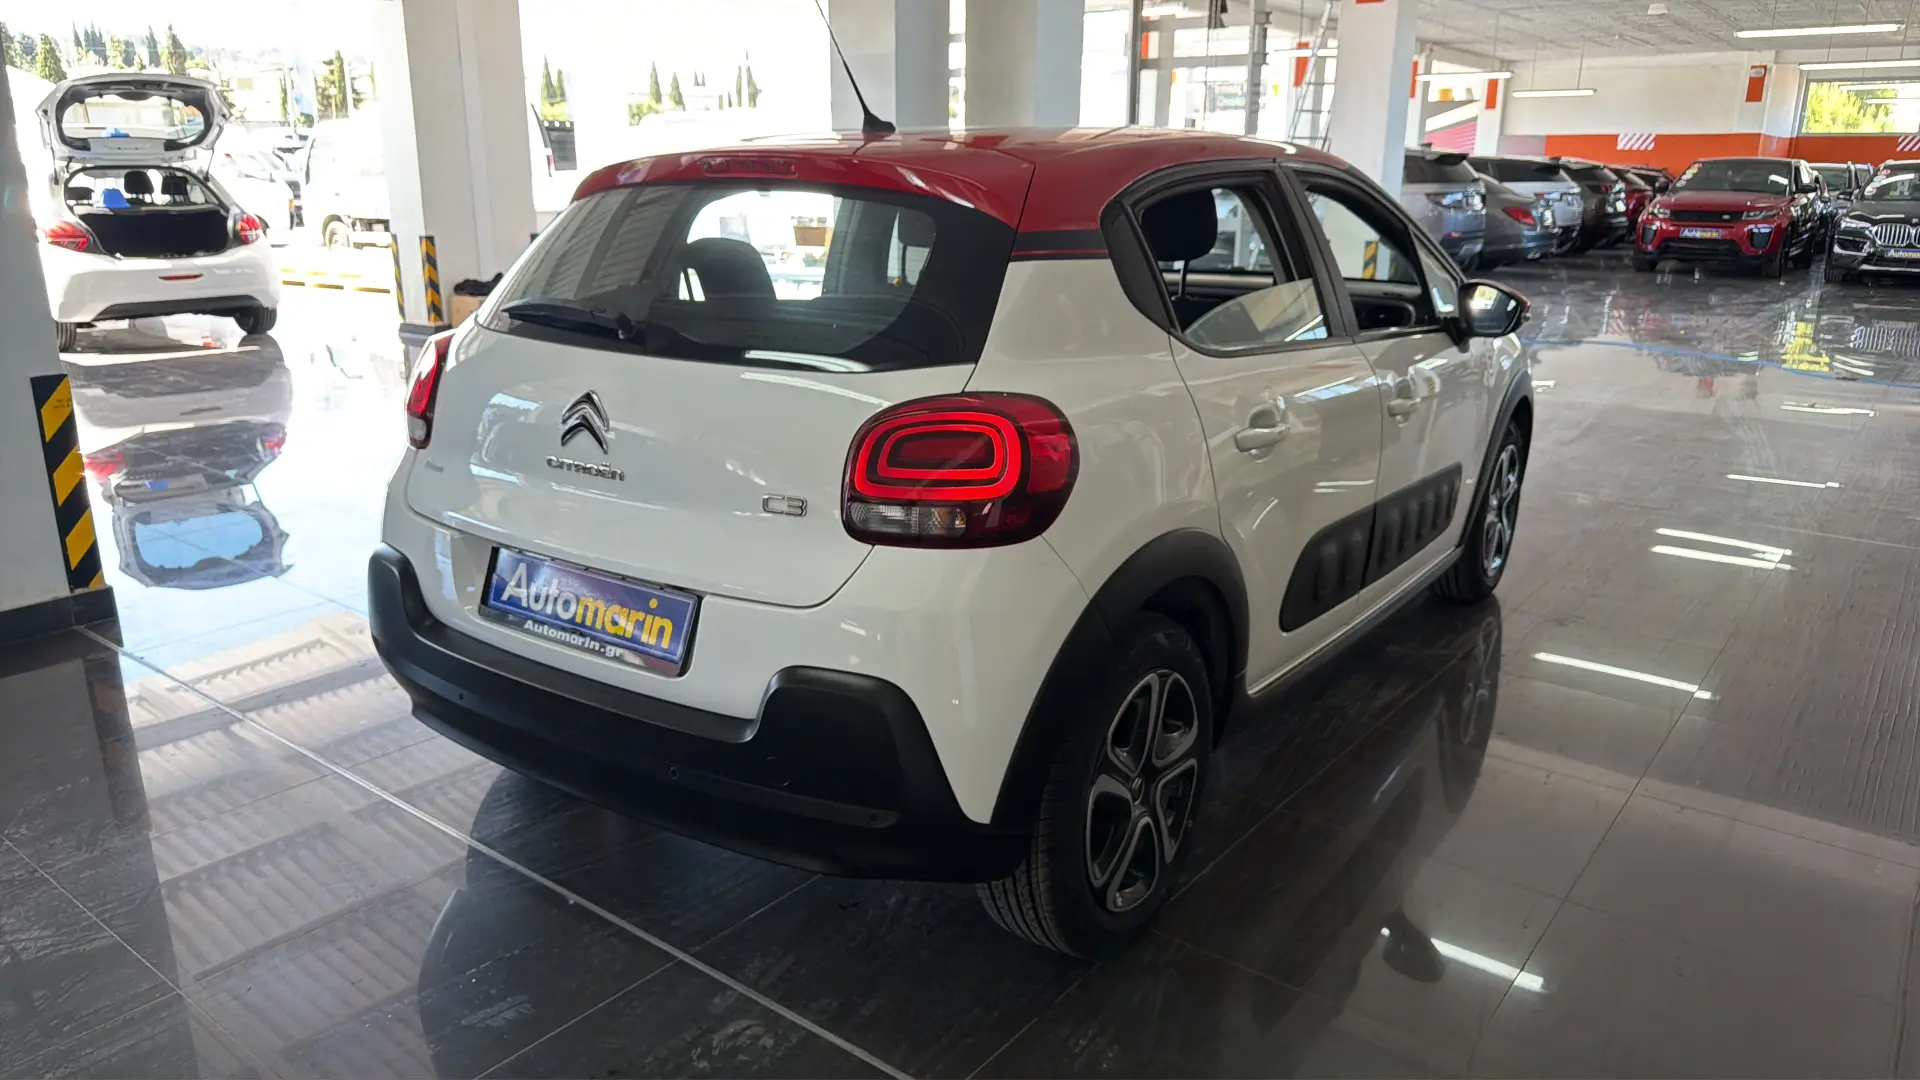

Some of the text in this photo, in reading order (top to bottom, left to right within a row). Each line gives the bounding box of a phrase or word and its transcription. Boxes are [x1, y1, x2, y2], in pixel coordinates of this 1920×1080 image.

[762, 493, 808, 517] C3
[501, 562, 673, 649] Automarin
[523, 619, 624, 658] Automarin.gr
